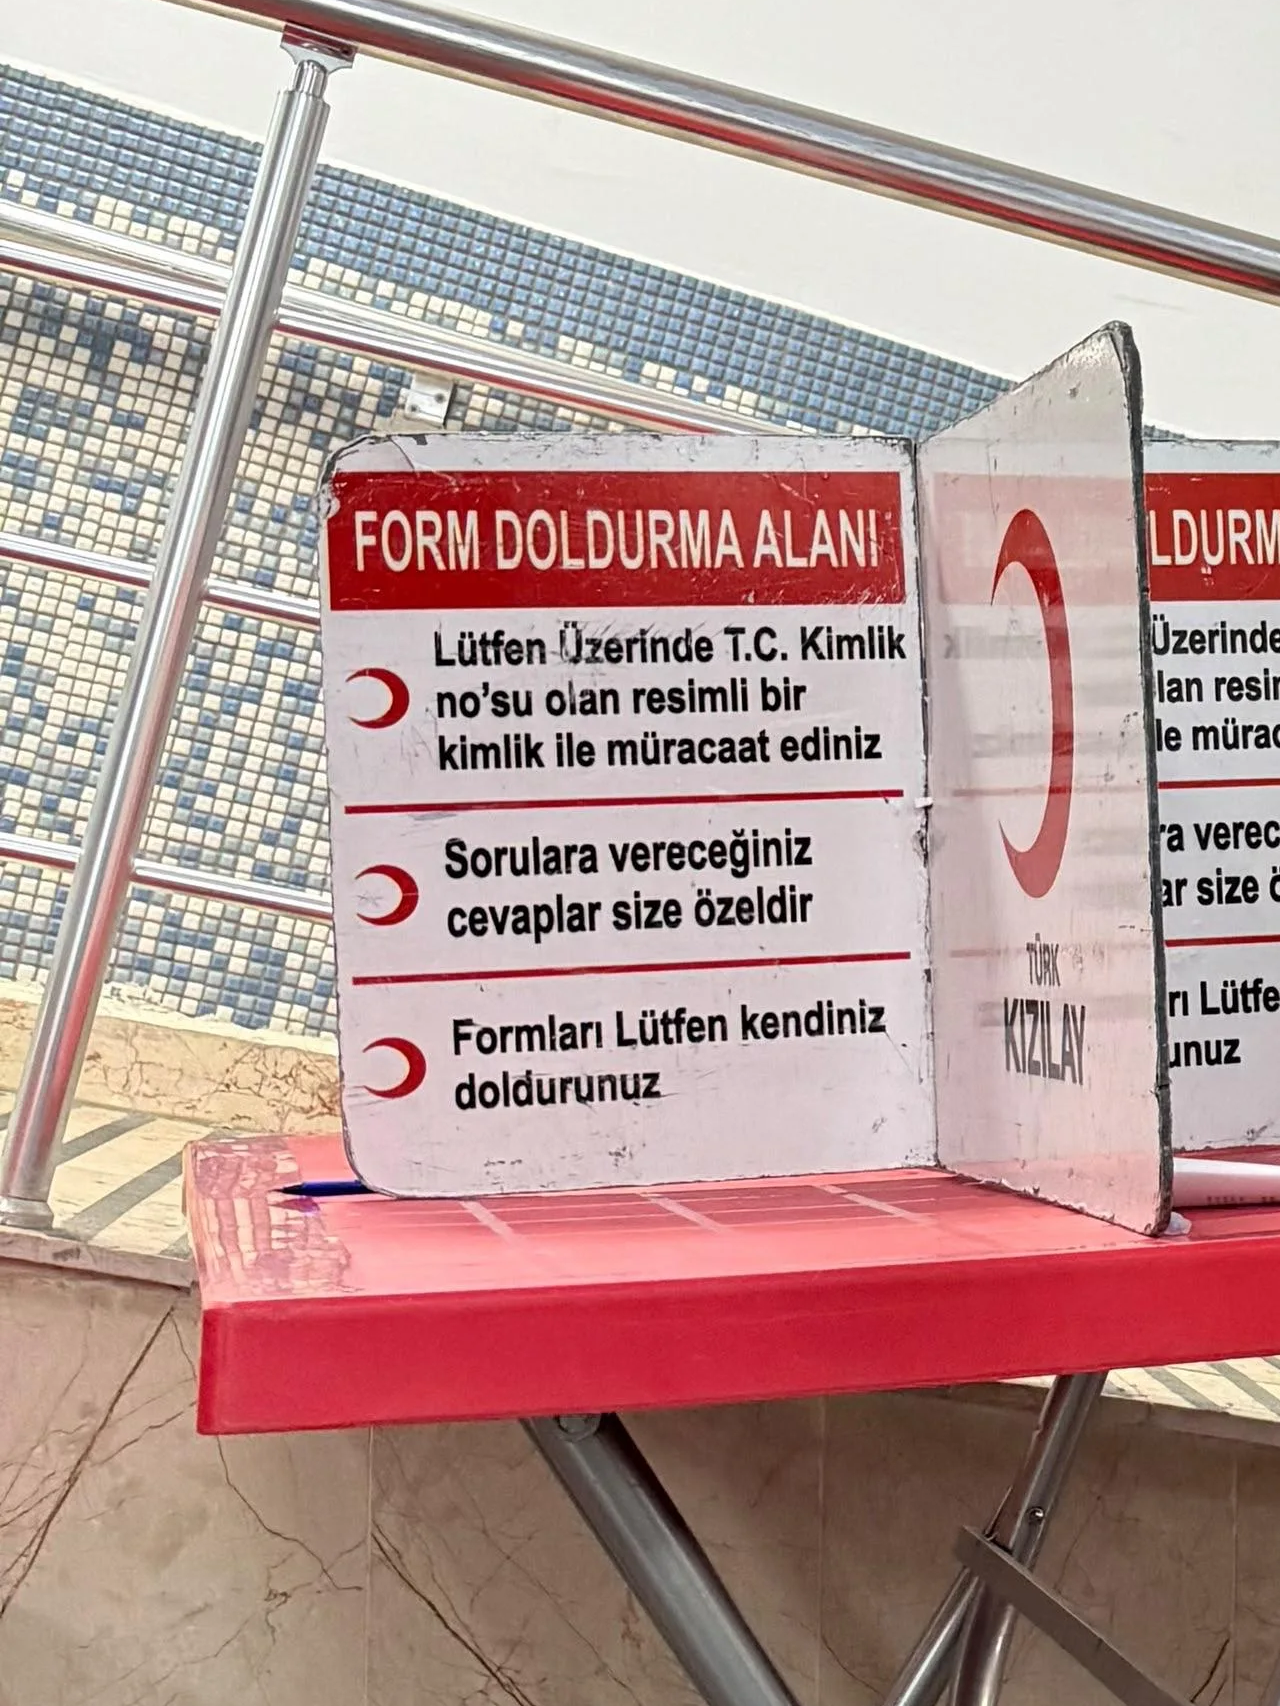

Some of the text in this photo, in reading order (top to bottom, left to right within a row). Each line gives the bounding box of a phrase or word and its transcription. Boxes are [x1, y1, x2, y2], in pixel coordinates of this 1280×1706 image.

[354, 508, 879, 572] FORM DOLDURMA ALANI
[434, 629, 547, 667] Lütfen
[559, 620, 714, 665] Üzerinde
[723, 626, 788, 663] T.C.
[800, 627, 907, 661] Kimlik
[545, 680, 620, 717] olan
[632, 679, 749, 715] resimli
[760, 680, 807, 713] bir
[1157, 669, 1204, 704] lan
[438, 725, 883, 771] kimlik ile müracaat ediniz
[1155, 718, 1182, 752] le
[444, 827, 813, 880] Sorulara vereceğiniz
[1196, 867, 1260, 906] size
[447, 886, 814, 945] cevaplar size özeldir
[1026, 932, 1061, 987] TÜRK
[452, 998, 887, 1056] Formları Lütfen kendiniz
[1004, 996, 1086, 1086] KIZILAY
[454, 1069, 662, 1111] doldurunuz
